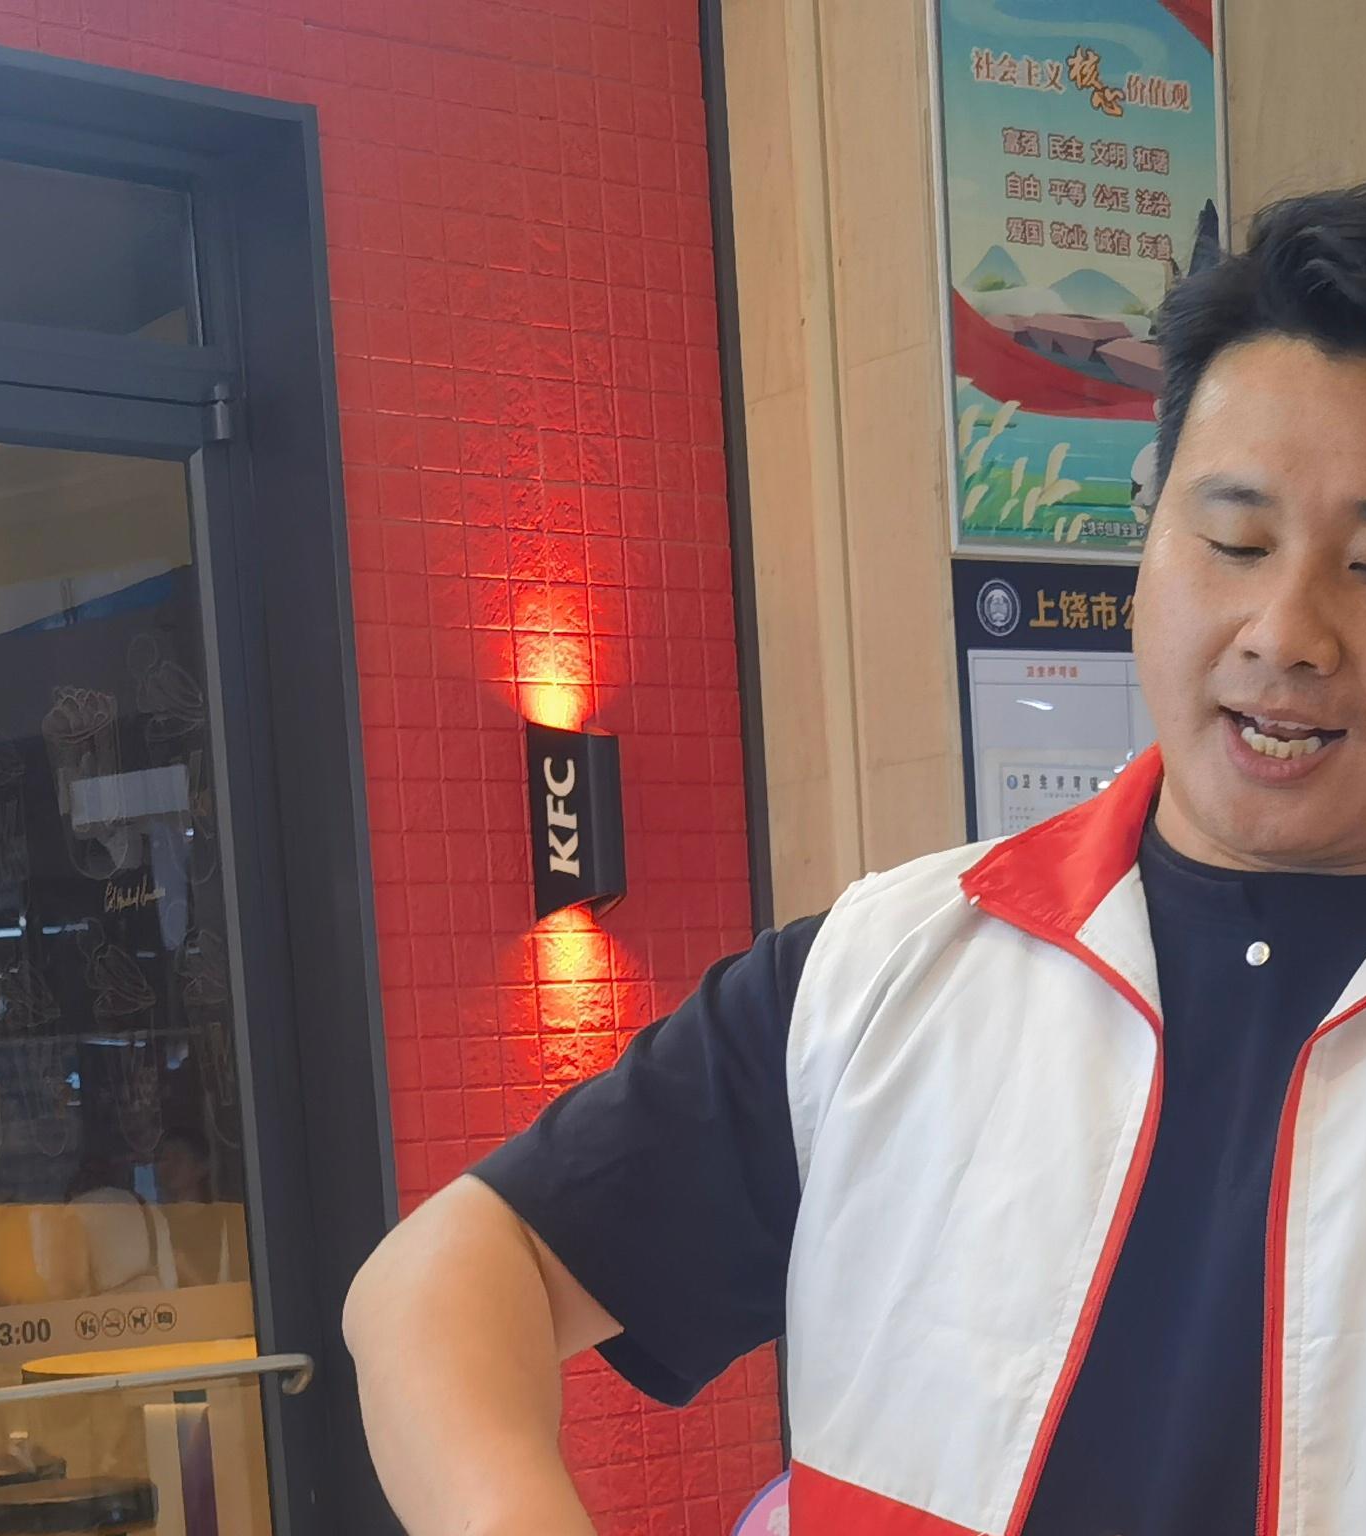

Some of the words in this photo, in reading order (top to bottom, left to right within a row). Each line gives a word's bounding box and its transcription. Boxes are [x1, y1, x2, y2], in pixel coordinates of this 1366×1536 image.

[972, 46, 1192, 117] 社会主义核心价值观
[1003, 127, 1040, 158] 富强
[1048, 133, 1084, 163] 民主
[1091, 139, 1127, 169] 文明
[1134, 146, 1169, 175] 和谐
[1006, 172, 1041, 202] 自由
[1049, 179, 1086, 207] 平等
[1094, 183, 1130, 212] 公正
[1136, 188, 1171, 218] 法治
[1007, 217, 1043, 246] 爱国
[1051, 221, 1088, 250] 敬业
[1094, 226, 1131, 256] 诚信
[1137, 232, 1172, 261] 友善
[543, 757, 580, 878] KFC
